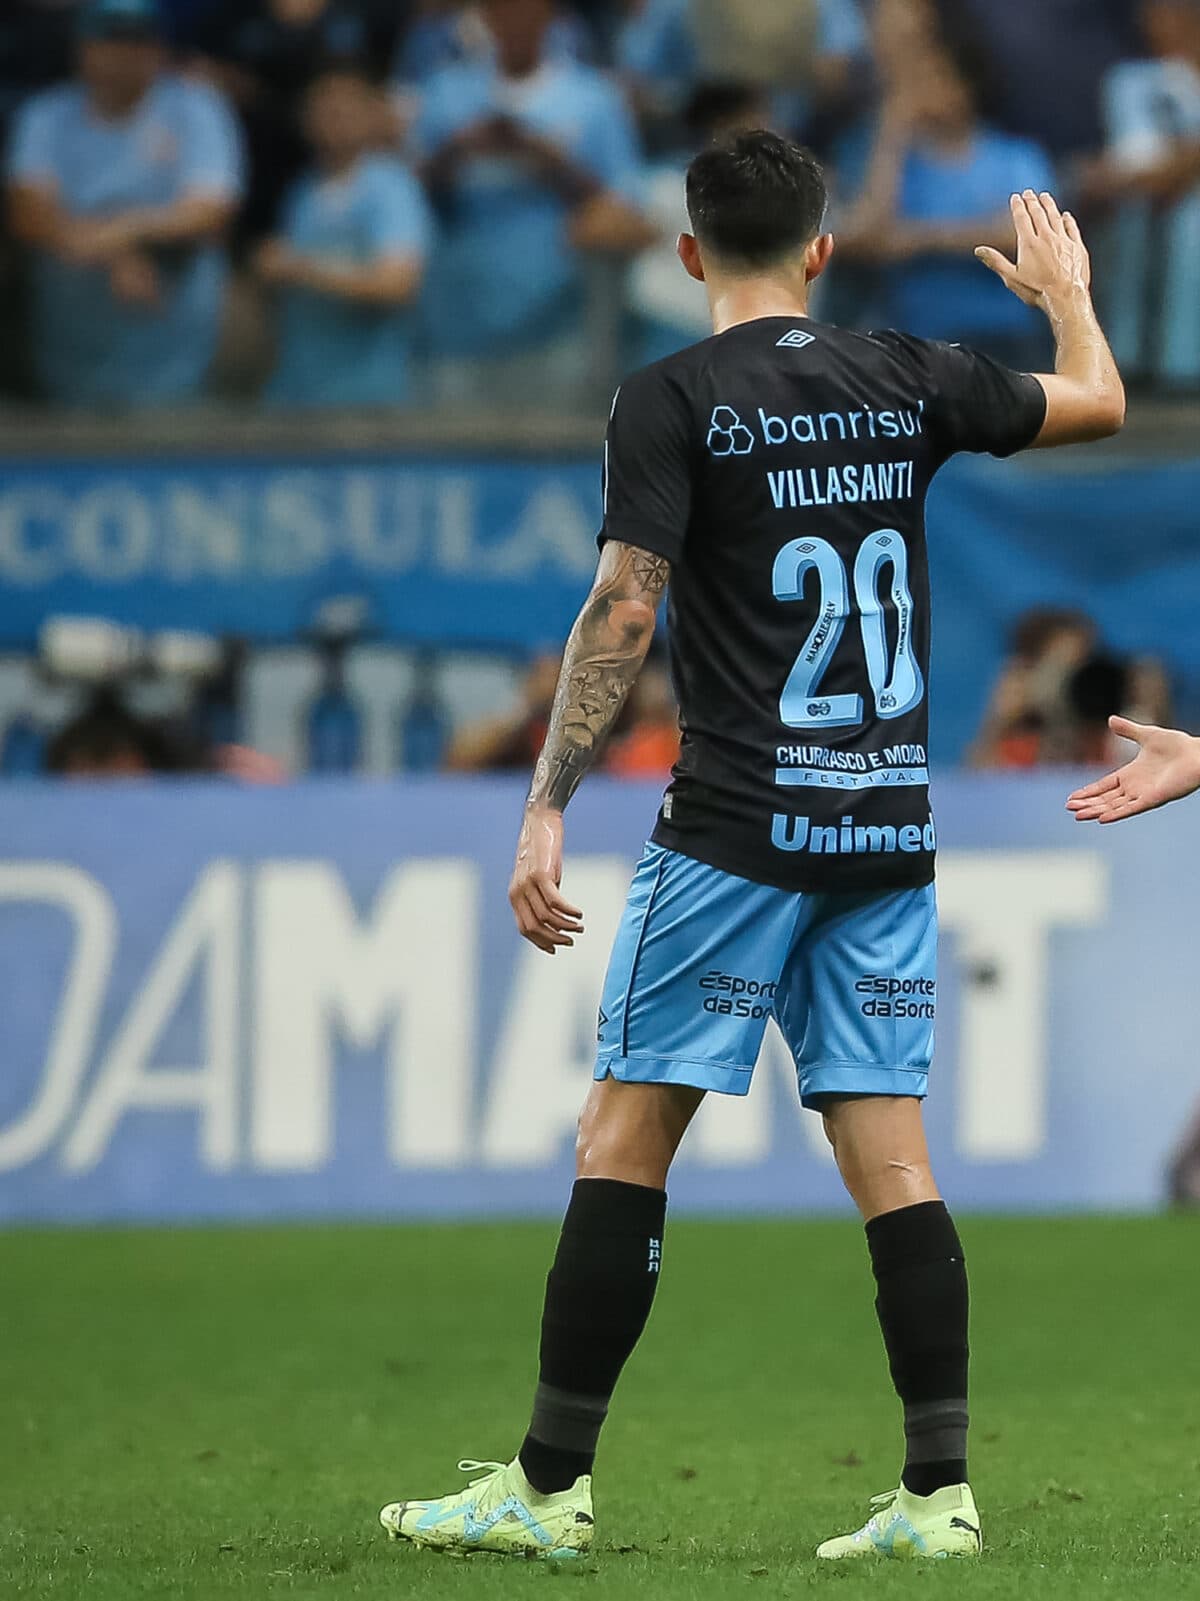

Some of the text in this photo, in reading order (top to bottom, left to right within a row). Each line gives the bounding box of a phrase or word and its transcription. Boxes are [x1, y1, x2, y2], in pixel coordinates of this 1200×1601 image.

[757, 400, 924, 445] banrisul
[767, 460, 913, 509] VILLASANTI
[772, 528, 925, 729] 20
[776, 745, 866, 771] CHURRASCO
[868, 752, 884, 768] E
[803, 771, 916, 786] FESTIVAL
[771, 812, 937, 853] Unimed
[855, 974, 936, 999] Esporte
